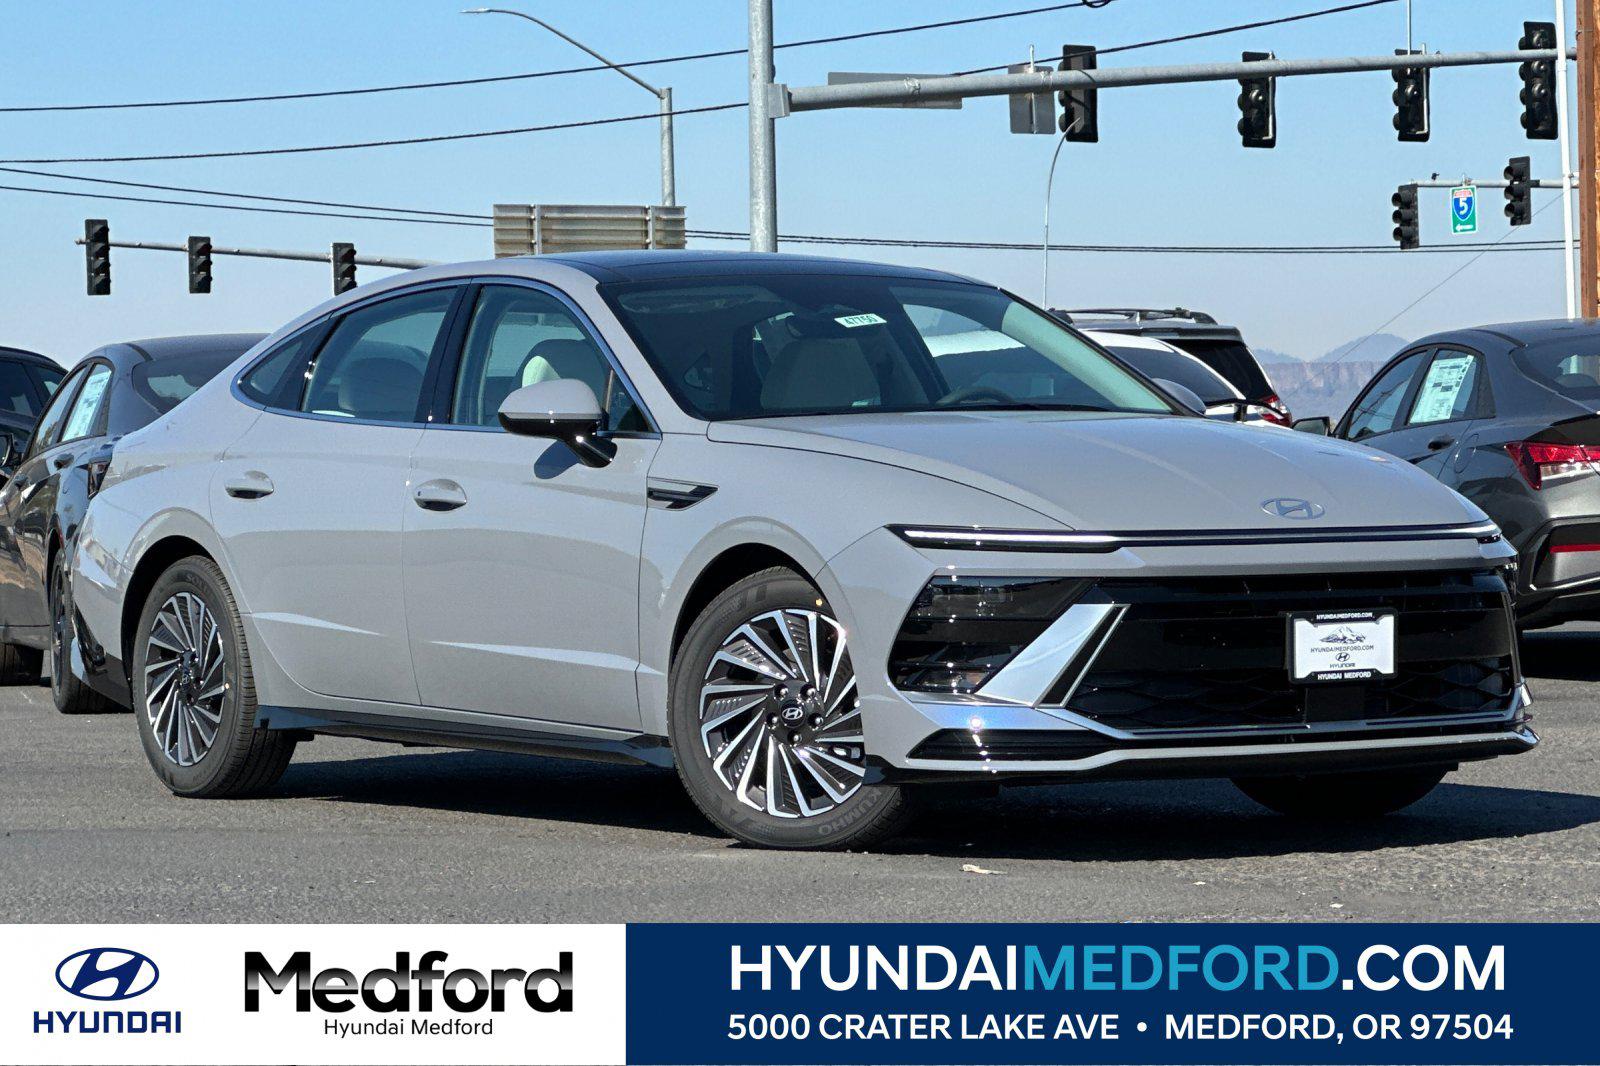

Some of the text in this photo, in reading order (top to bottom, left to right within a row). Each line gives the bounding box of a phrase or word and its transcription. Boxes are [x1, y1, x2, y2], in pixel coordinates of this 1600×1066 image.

[1459, 197, 1469, 215] 5
[1316, 612, 1373, 620] HYUNDAIMEDFORD.COM
[1310, 645, 1374, 653] HYUNDAIMEDFORD.COM
[1317, 671, 1371, 680] HYUNDAI MEDFORD
[817, 787, 882, 836] KUMHO
